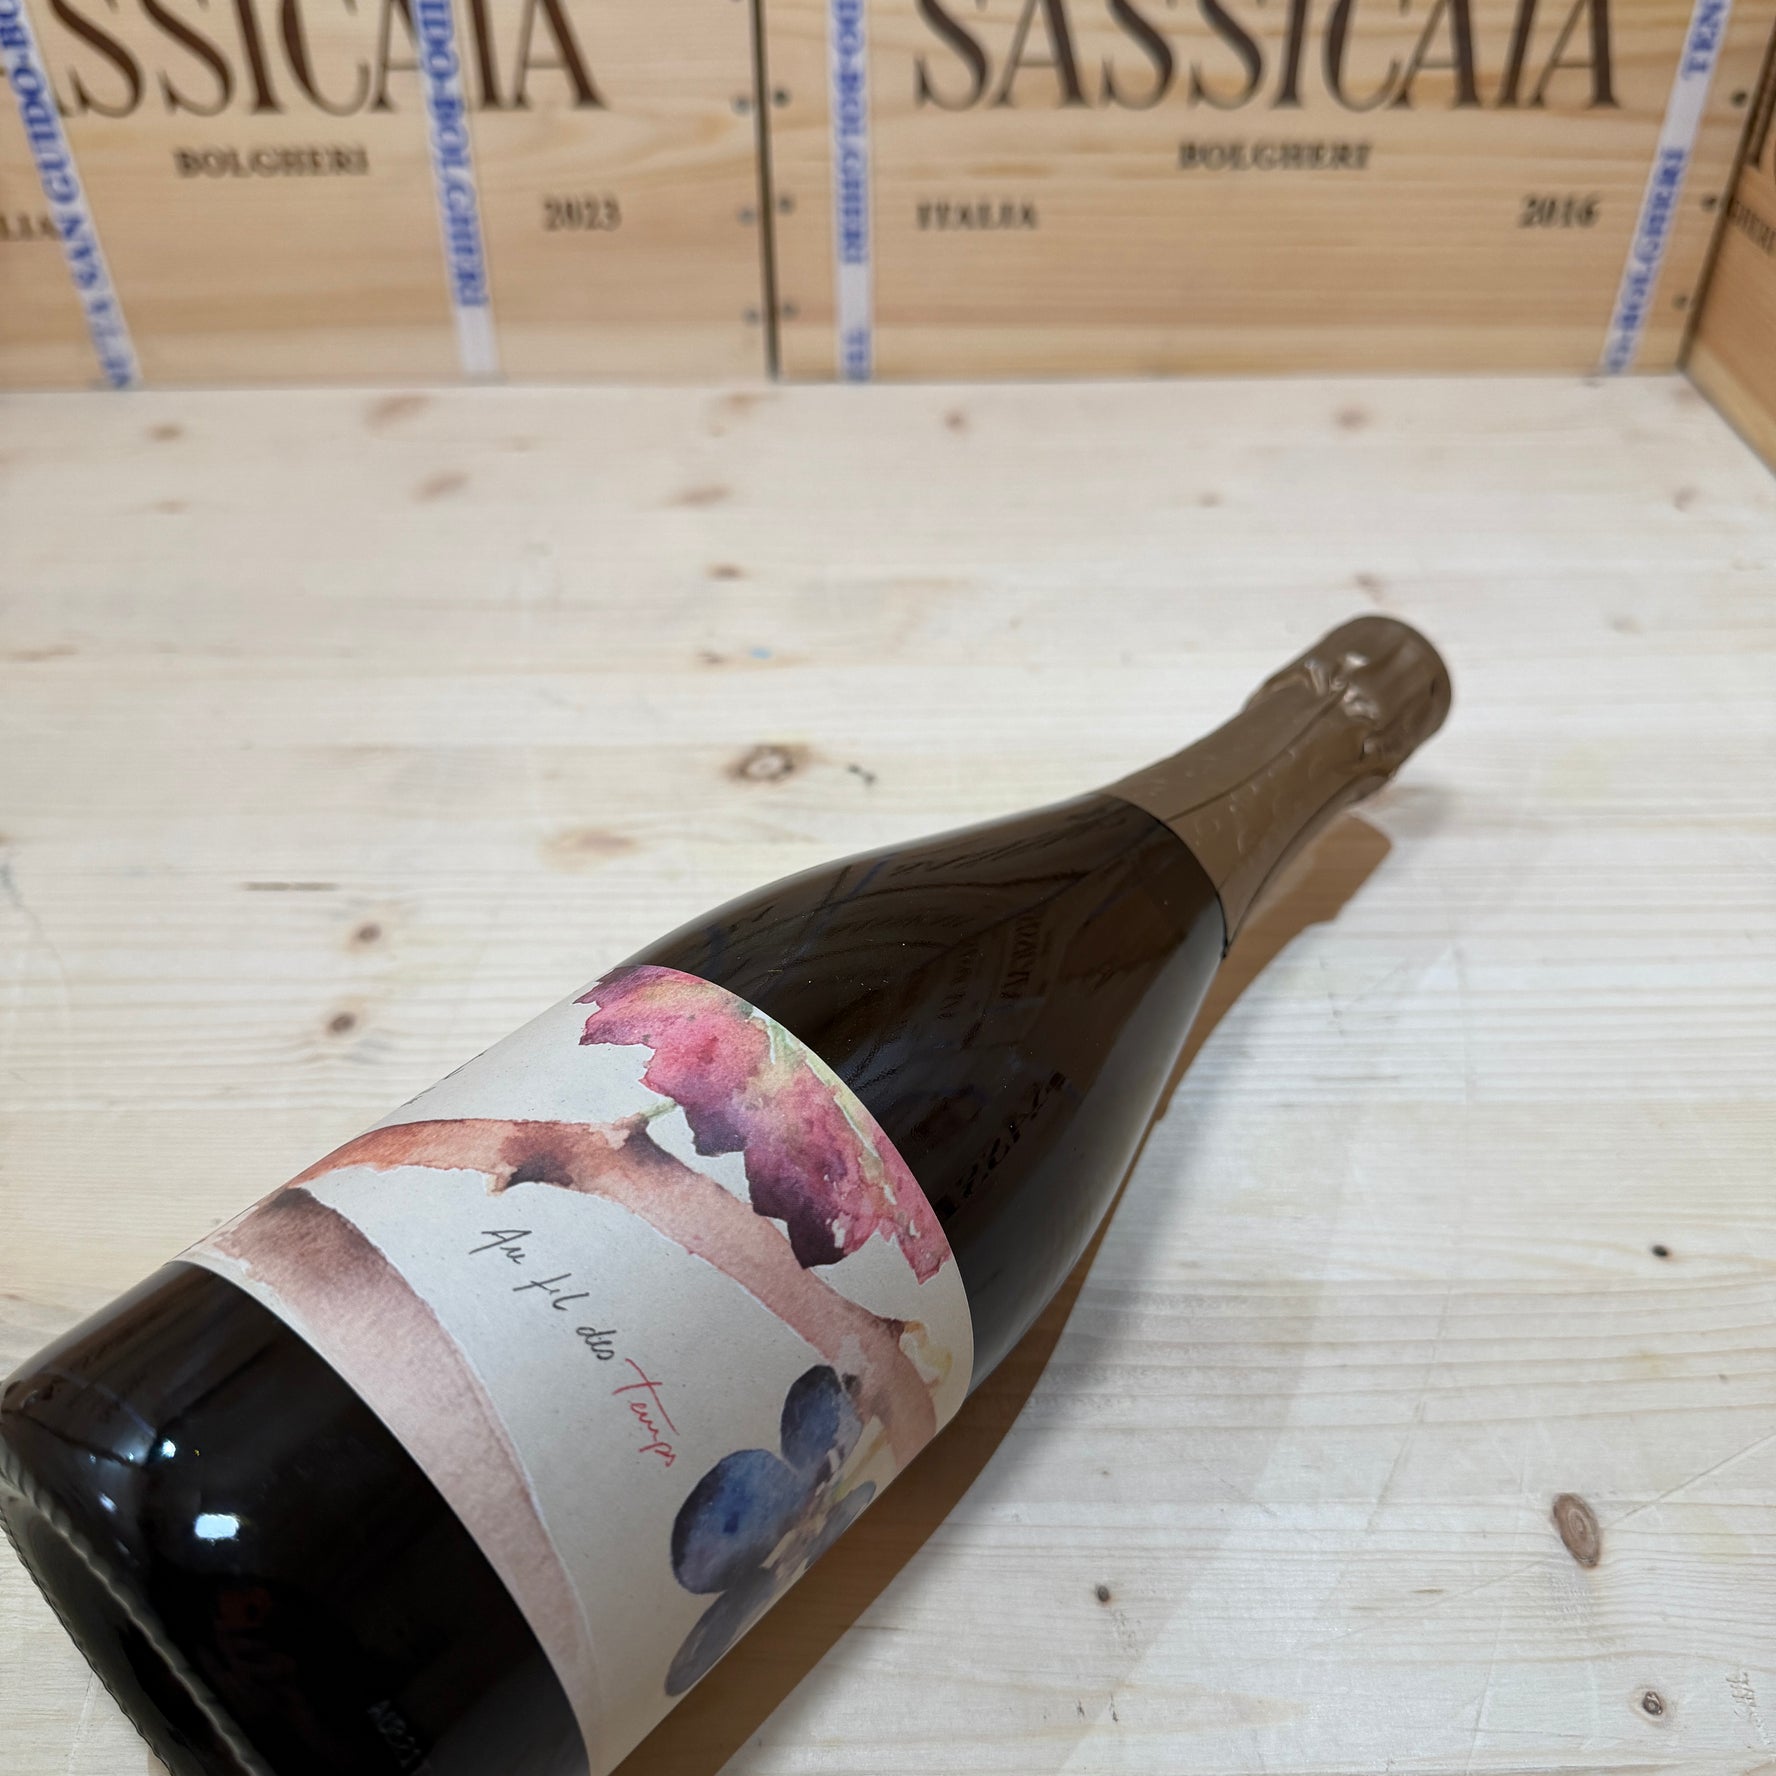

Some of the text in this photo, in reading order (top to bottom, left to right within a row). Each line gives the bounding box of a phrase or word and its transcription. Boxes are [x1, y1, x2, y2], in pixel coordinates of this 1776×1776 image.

[173, 146, 370, 178] BOLGHERI
[1177, 141, 1371, 171] BOLGHERI
[543, 196, 623, 231] 2023
[915, 201, 1038, 231] ITALIA
[1518, 195, 1602, 229] 2016
[468, 1229, 532, 1265] Au
[512, 1272, 590, 1311] fil
[611, 1357, 680, 1468] Temps
